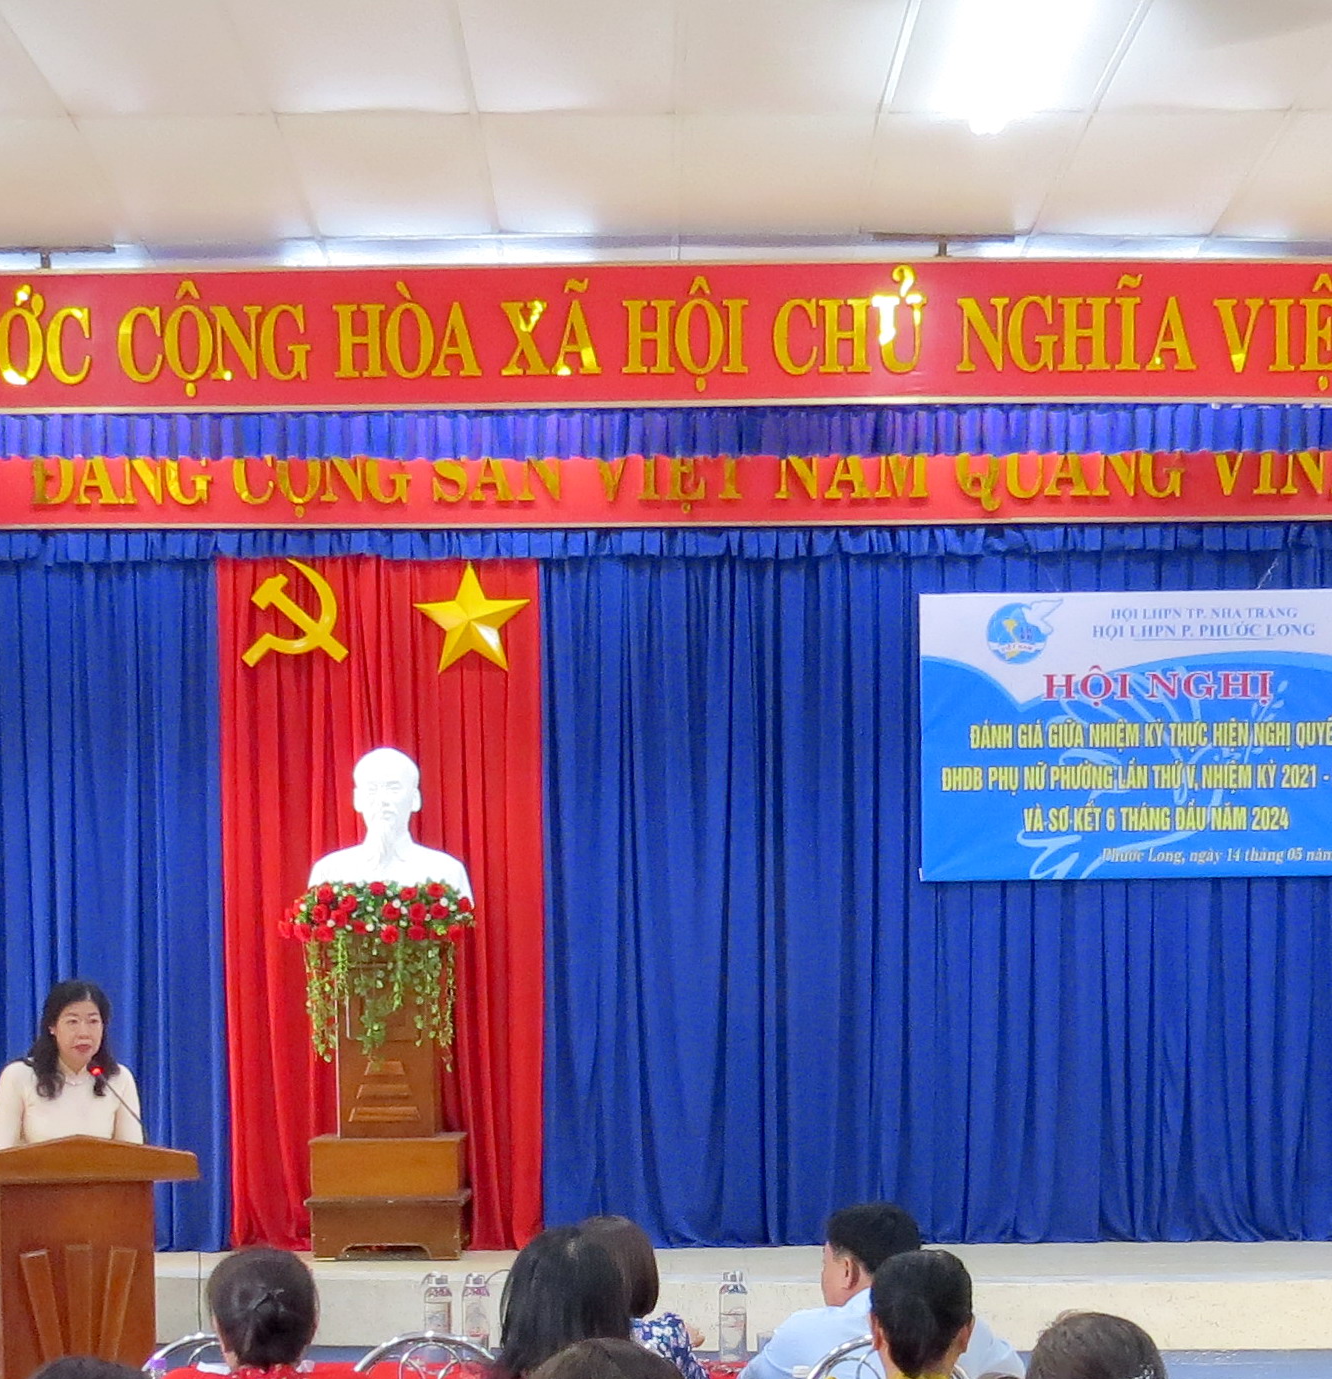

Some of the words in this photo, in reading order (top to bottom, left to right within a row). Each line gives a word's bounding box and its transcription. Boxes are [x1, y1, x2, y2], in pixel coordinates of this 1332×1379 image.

[117, 281, 311, 396] CỘNG
[332, 282, 481, 378] HÒA
[501, 278, 603, 377] XÃ
[622, 276, 749, 393] HỘI
[773, 265, 928, 376] CHỦ
[956, 274, 1197, 374] NGHĨA
[774, 455, 929, 500] NAM
[954, 451, 1185, 512] QUANG
[1130, 624, 1176, 638] LHPN
[1181, 624, 1194, 638] P.
[1265, 623, 1316, 638] LONG
[1211, 608, 1242, 620] NHA
[1246, 606, 1300, 620] TRANG
[1043, 664, 1133, 708] HỘI
[1146, 670, 1275, 706] NGHỊ
[970, 718, 1013, 749] ĐÁNH
[1017, 718, 1044, 749] GIÁ
[1047, 717, 1085, 749] GIỮA
[1089, 717, 1141, 753] NHIỆM
[1168, 721, 1209, 753] THỰC
[1212, 717, 1250, 753] HIỆN
[1254, 721, 1292, 752] NGHỊ
[987, 766, 1019, 796] PHỤ
[1023, 761, 1048, 791] NỮ
[1049, 760, 1114, 791] PHƯỜNG
[1152, 759, 1184, 789] THỨ
[1201, 760, 1253, 794] NHIỆM
[1281, 763, 1317, 789] 2021
[1023, 803, 1045, 832] VÀ
[1047, 804, 1070, 832] SƠ
[1073, 798, 1103, 832] KẾT
[1105, 807, 1116, 832] 6
[1120, 802, 1171, 831] THÁNG
[1174, 798, 1208, 831] ĐẦU
[1210, 801, 1248, 831] NĂM
[1251, 806, 1290, 831] 2024
[1148, 847, 1186, 865] Long,
[1188, 849, 1222, 865] ngày
